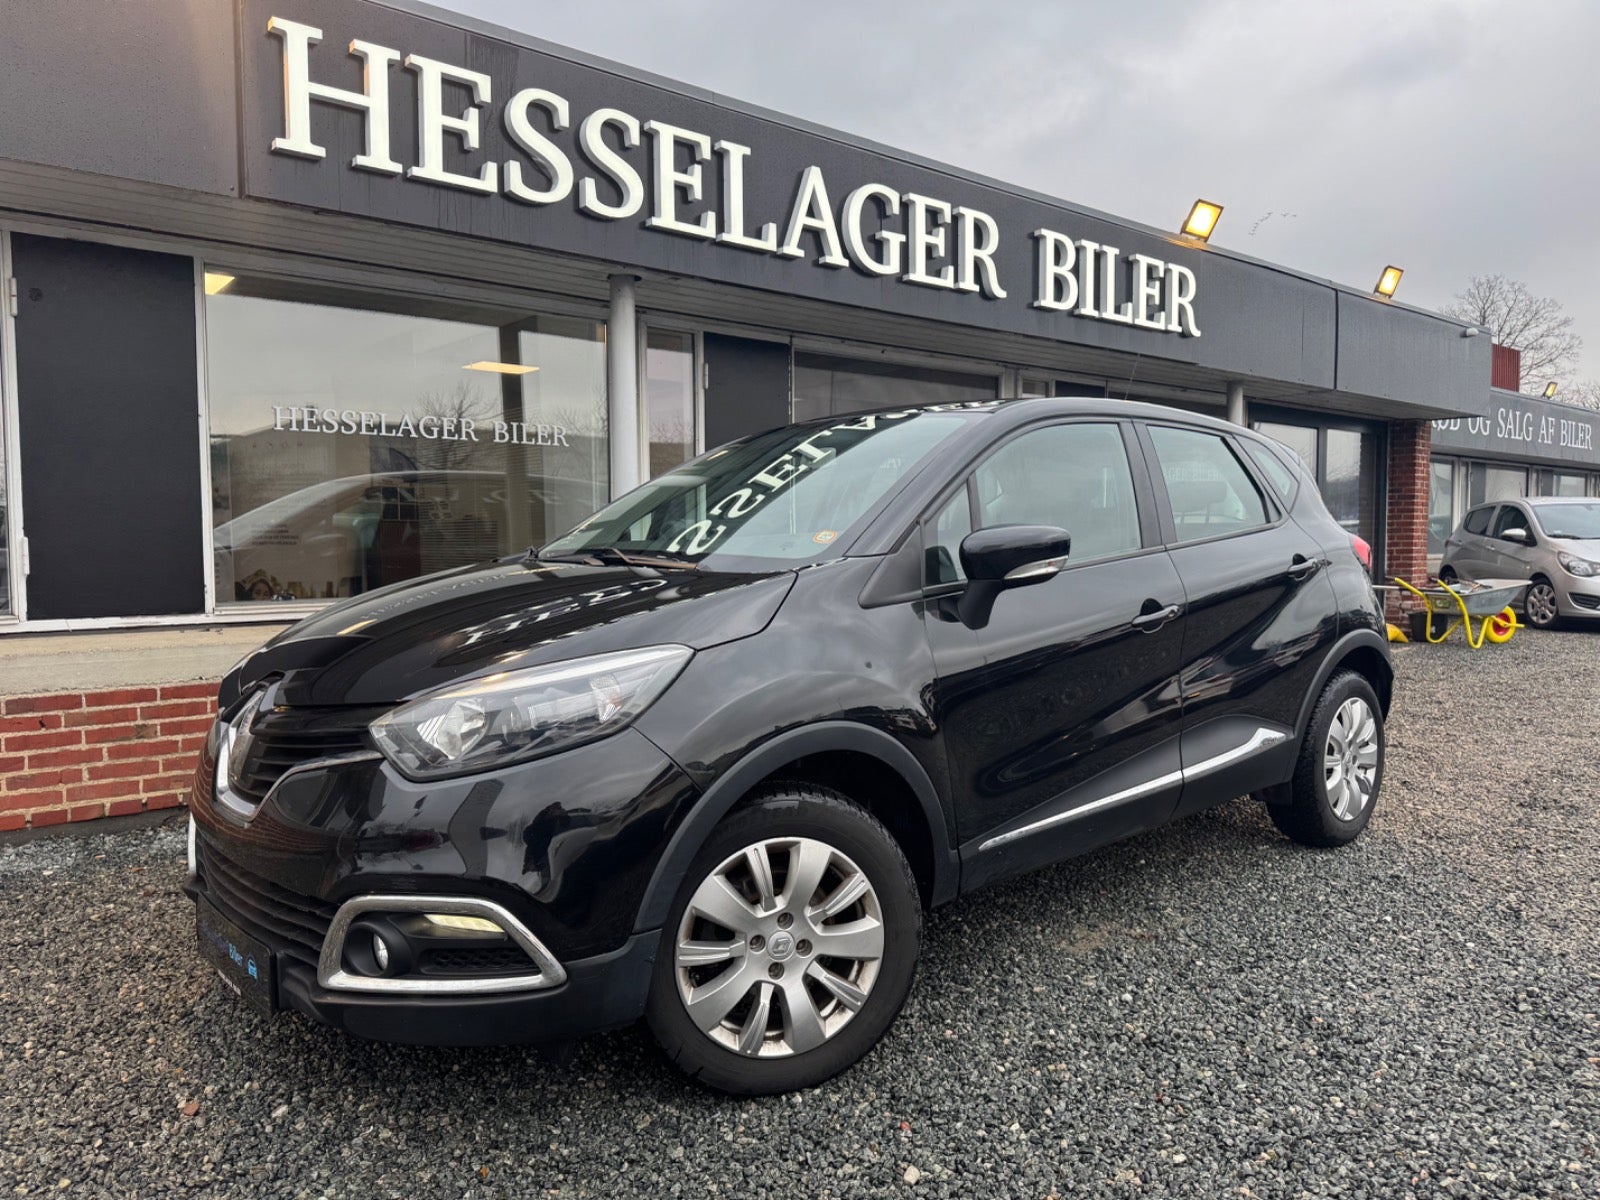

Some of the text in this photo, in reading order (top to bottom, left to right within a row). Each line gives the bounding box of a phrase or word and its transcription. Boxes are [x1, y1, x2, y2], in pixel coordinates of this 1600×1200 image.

[268, 17, 1201, 337] HESSELAGER BILER
[272, 405, 570, 447] HESSELAGER BILER
[1497, 407, 1533, 441] SALG
[1538, 415, 1555, 444] AF
[1560, 419, 1592, 450] BILER
